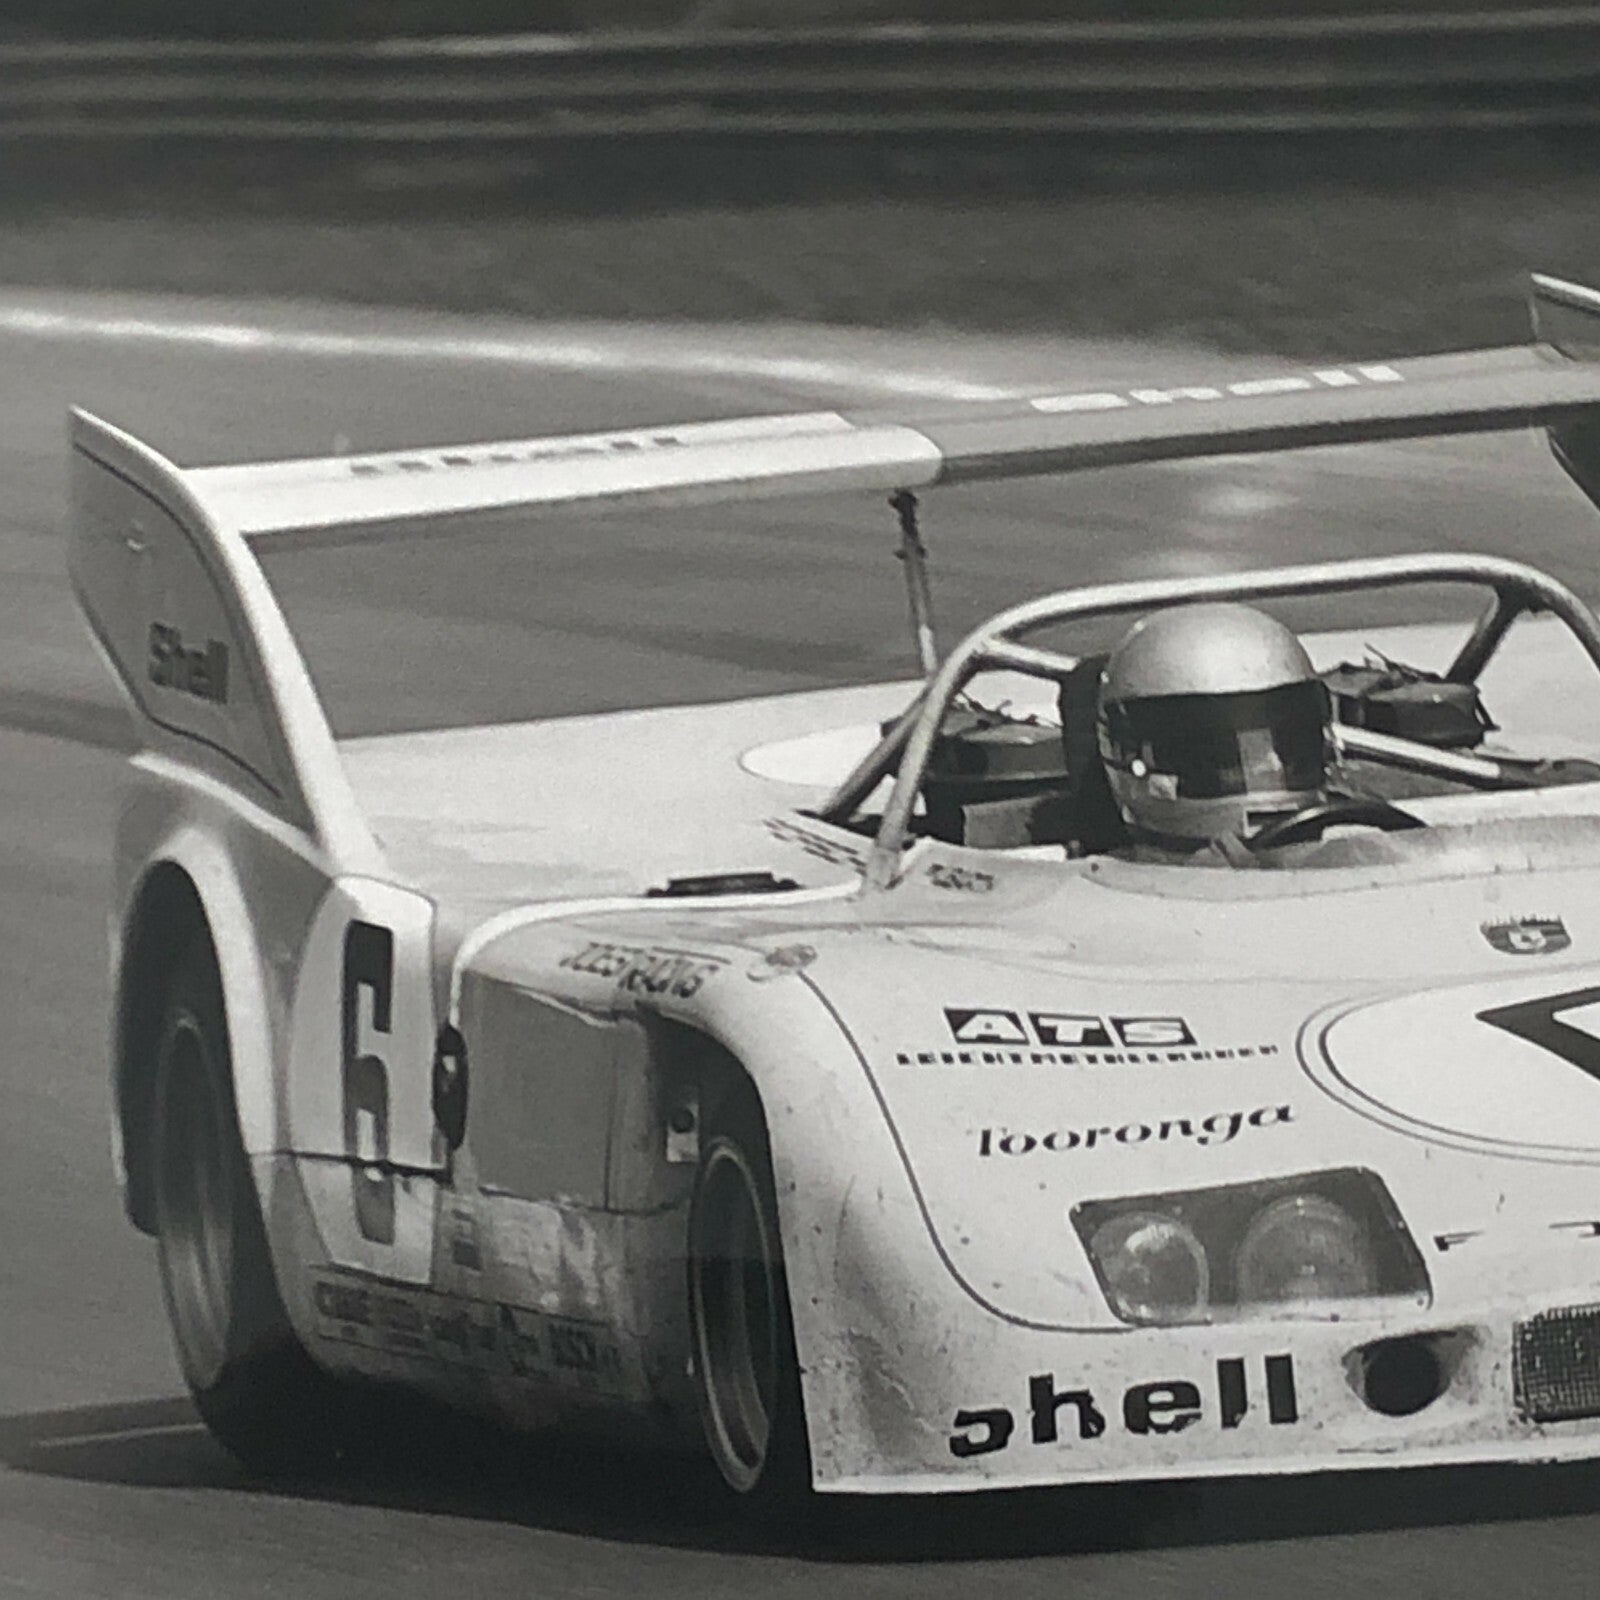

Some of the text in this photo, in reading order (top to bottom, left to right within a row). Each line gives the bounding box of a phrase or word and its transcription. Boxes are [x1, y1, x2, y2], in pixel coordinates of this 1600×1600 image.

[945, 1008, 1196, 1047] ATS
[342, 919, 394, 1245] 6
[968, 1102, 1296, 1158] Tooronga
[949, 1353, 1300, 1458] shell
